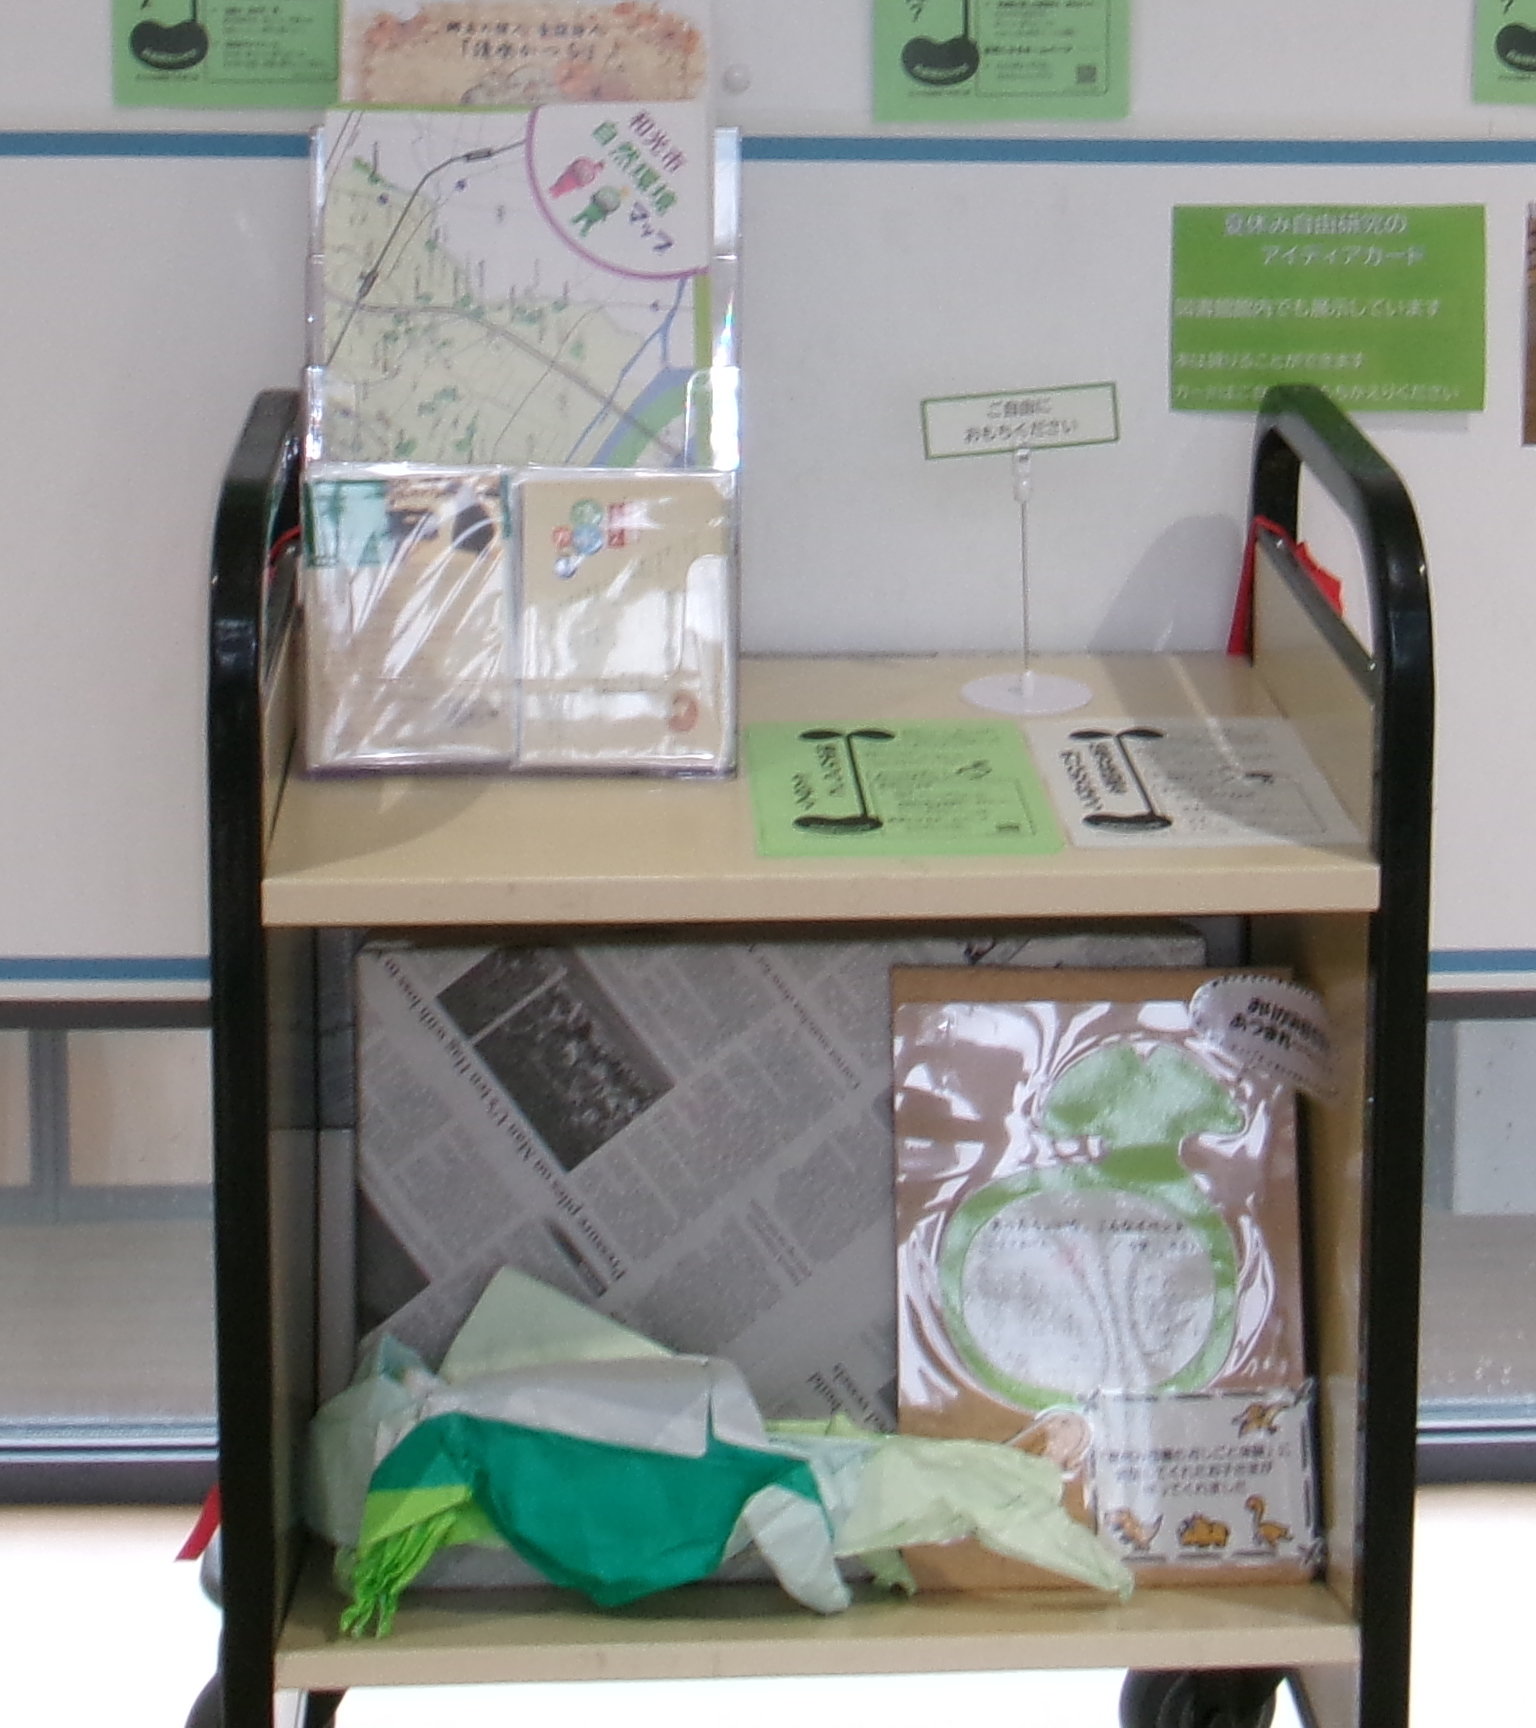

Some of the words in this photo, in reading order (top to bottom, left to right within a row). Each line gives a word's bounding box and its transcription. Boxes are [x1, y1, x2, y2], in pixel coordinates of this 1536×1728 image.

[591, 121, 677, 216] 自然環境
[629, 111, 685, 173] 和光市
[629, 202, 674, 255] マップ
[1223, 213, 1408, 236] 夏休み自由研究の
[1262, 244, 1425, 268] アイディアカード
